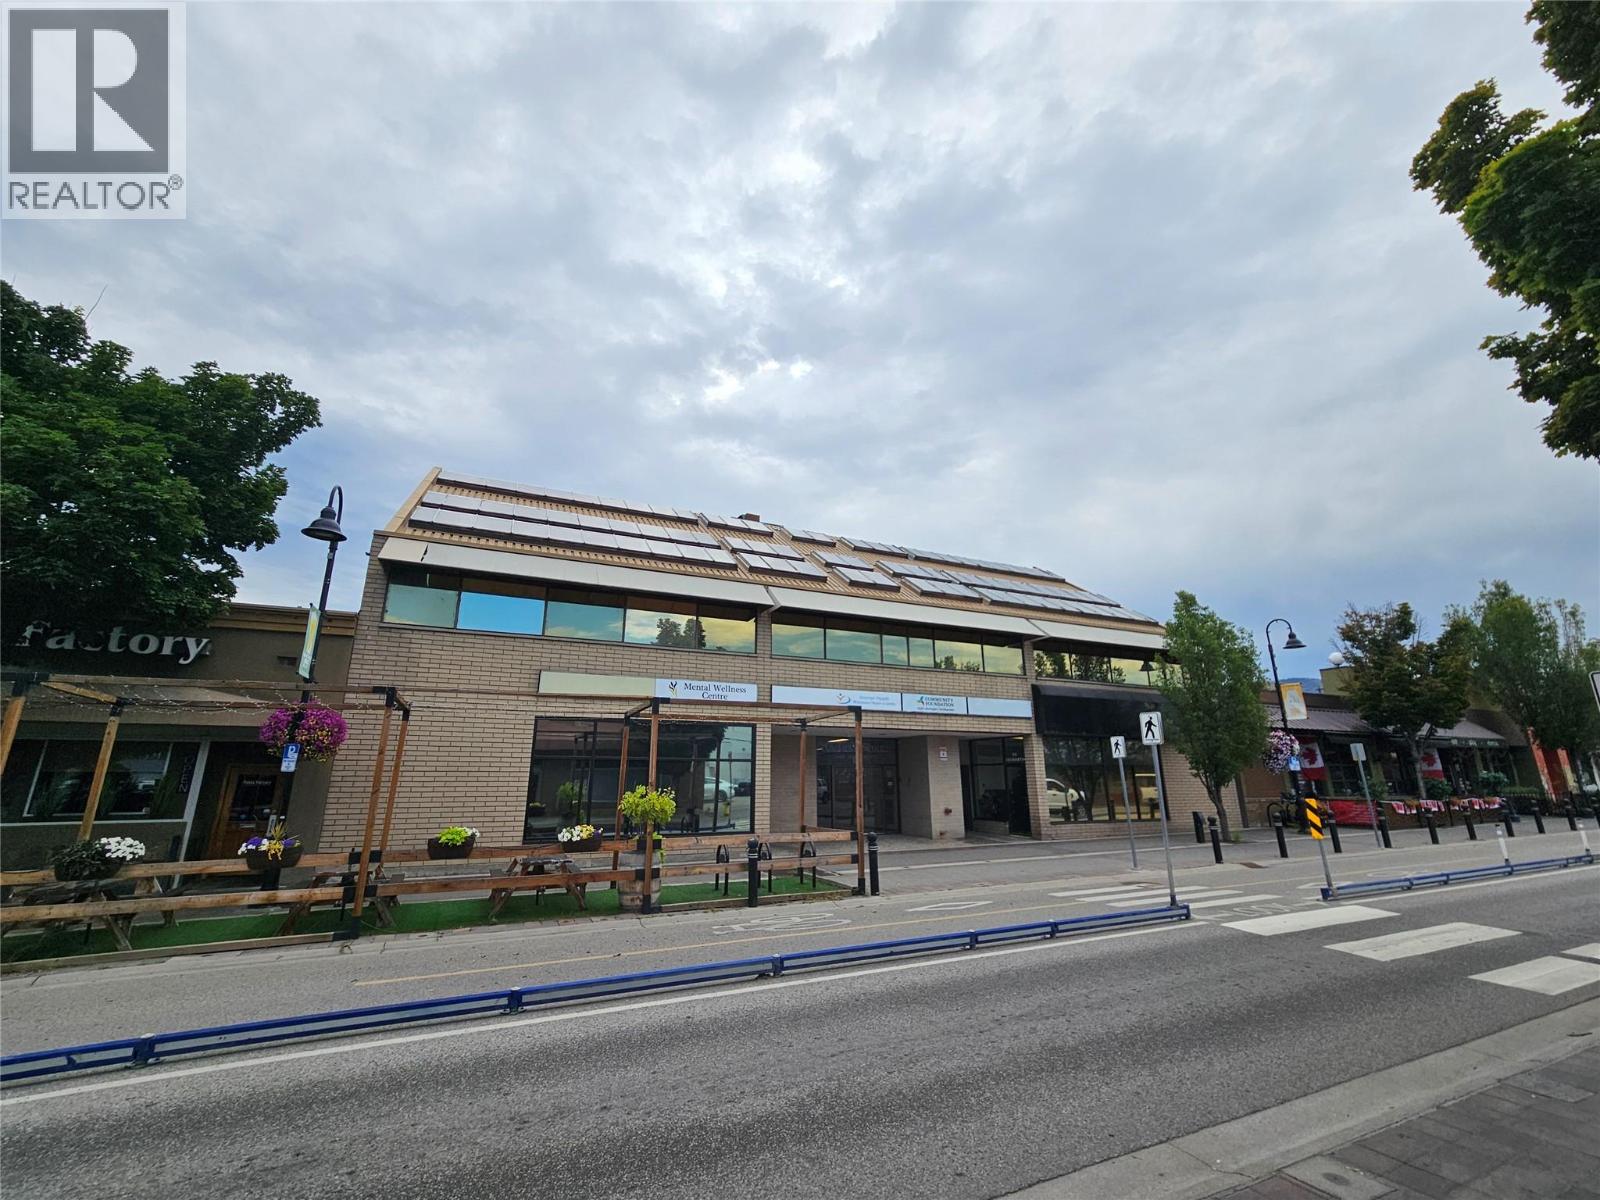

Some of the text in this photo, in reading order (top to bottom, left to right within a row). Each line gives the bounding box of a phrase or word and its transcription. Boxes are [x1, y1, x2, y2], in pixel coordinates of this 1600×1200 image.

[684, 682, 747, 694] Mental Wellness
[701, 691, 728, 700] Centre
